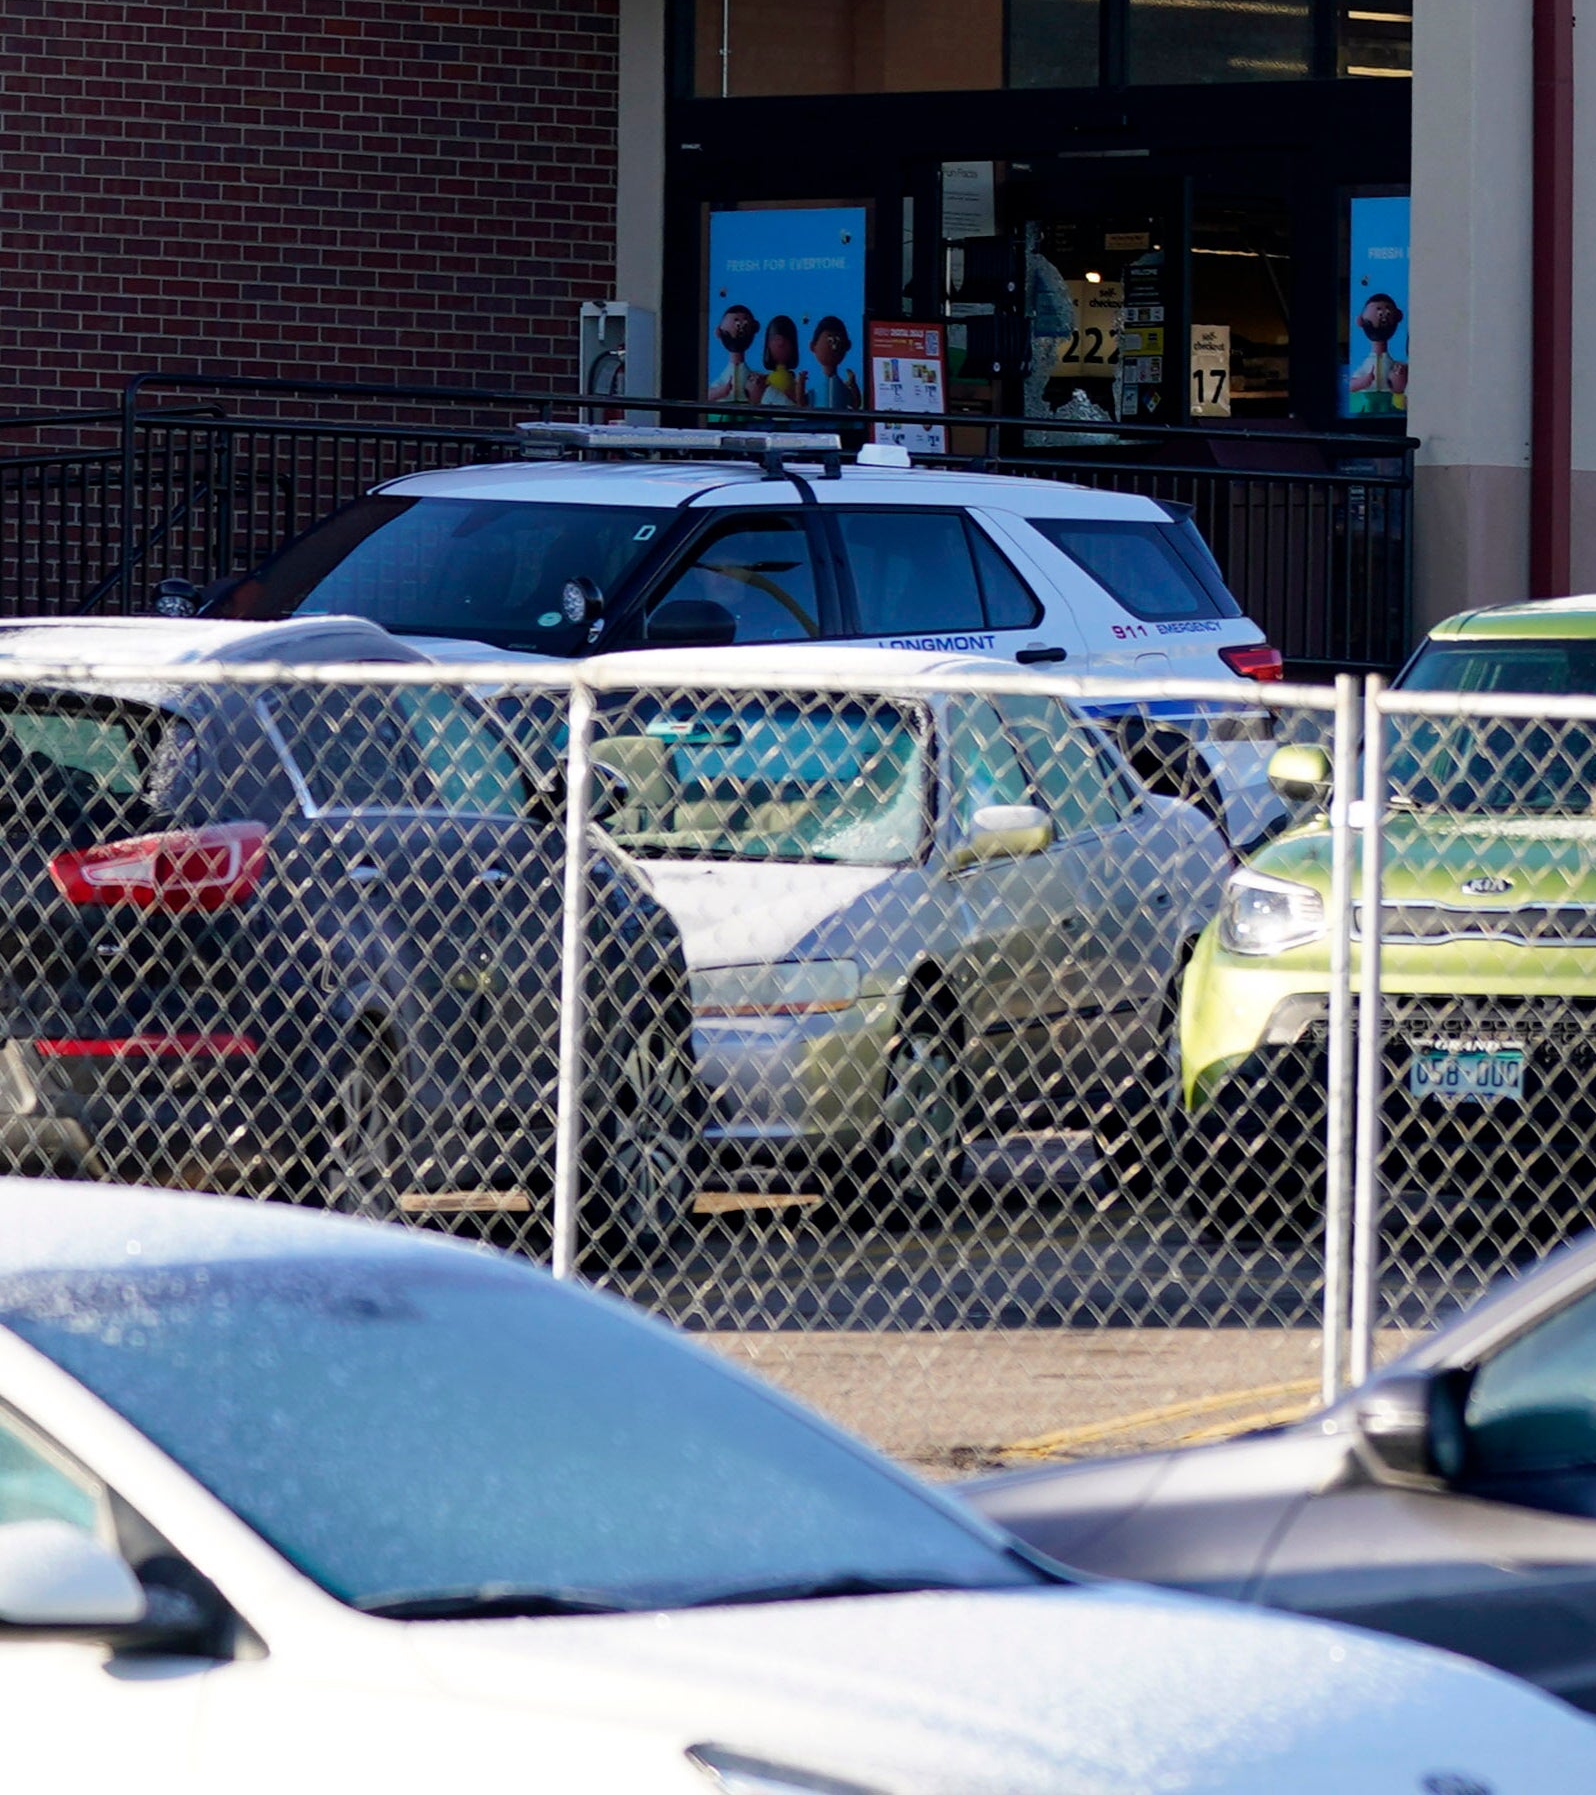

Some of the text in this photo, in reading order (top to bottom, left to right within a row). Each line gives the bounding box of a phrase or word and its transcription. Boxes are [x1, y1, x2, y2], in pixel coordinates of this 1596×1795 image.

[1368, 247, 1404, 260] FRESH
[726, 258, 760, 272] FRESH
[763, 257, 785, 271] FOR
[1193, 369, 1227, 404] 17
[1111, 621, 1222, 640] 911 EMERGENCY
